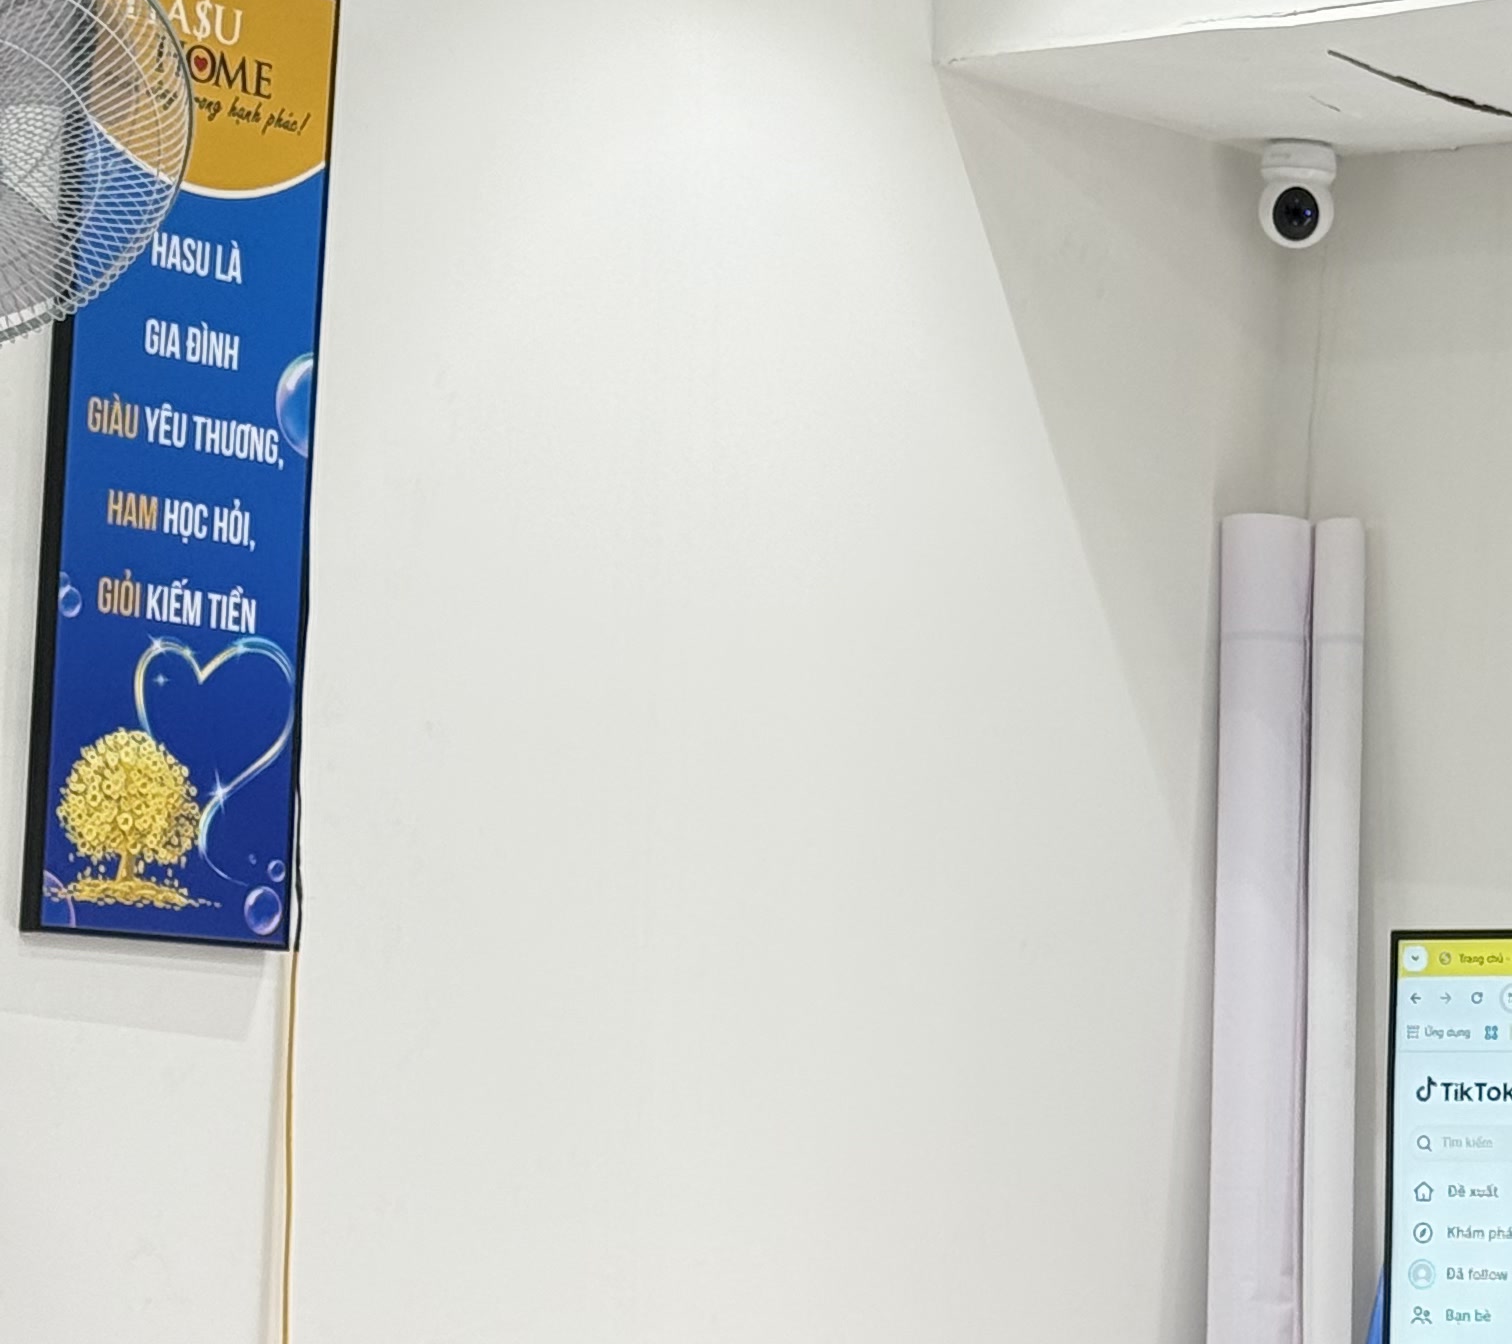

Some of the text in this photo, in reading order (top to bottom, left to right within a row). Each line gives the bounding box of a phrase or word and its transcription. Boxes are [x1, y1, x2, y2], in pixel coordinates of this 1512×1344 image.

[151, 231, 243, 285] HASU LÀ
[145, 318, 240, 371] GIA ĐÌNH
[87, 392, 285, 470] GIÀU YÊU THƯƠNG,
[107, 489, 256, 552] HAM HỌC HỎI,
[97, 568, 257, 635] GIỎI KIẾM TIỀN
[1446, 1226, 1486, 1241] Khám
